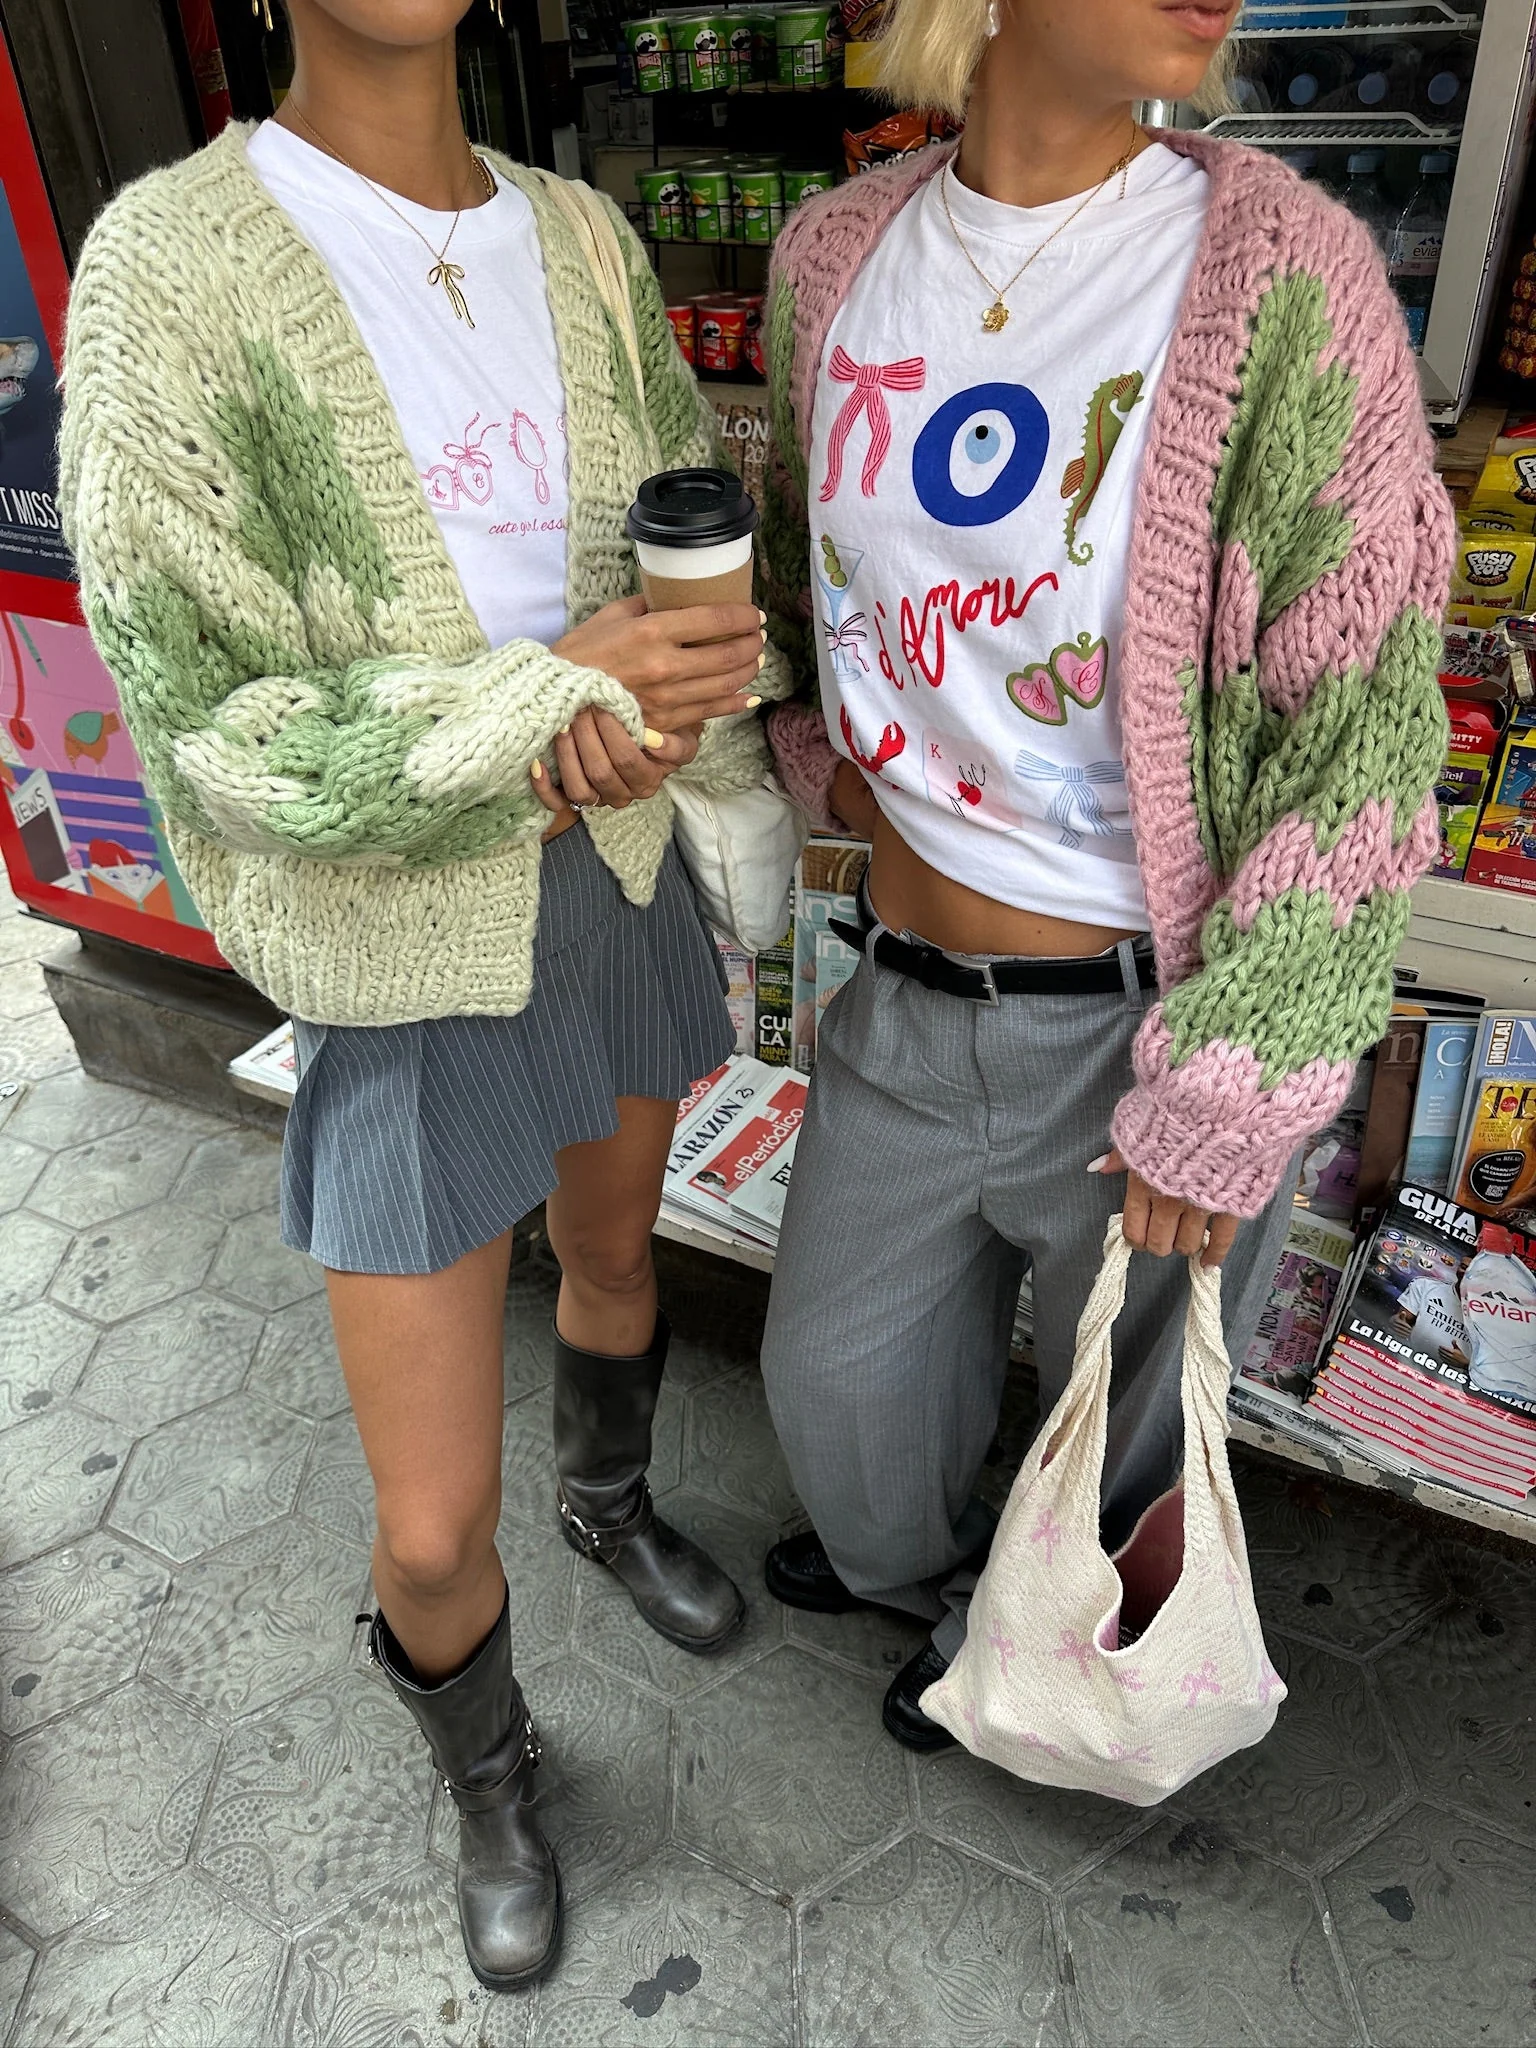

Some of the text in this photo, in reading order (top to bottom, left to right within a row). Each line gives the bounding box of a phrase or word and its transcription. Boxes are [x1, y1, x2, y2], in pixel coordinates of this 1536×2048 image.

[744, 445, 768, 464] 20
[10, 488, 59, 530] MISS
[488, 521, 518, 534] cute
[520, 518, 538, 536] girl
[1467, 551, 1515, 567] PUSH
[1473, 563, 1508, 576] POP
[930, 743, 942, 759] K
[760, 1030, 786, 1047] LA
[1488, 1021, 1513, 1064] ¡HOLA!
[682, 1098, 744, 1151] RAZÓN
[734, 1108, 804, 1181] elPeriódico
[1398, 1187, 1477, 1237] GUÍA
[1414, 1210, 1434, 1225] DE
[1433, 1219, 1451, 1234] LA
[1430, 1317, 1443, 1328] FLY
[1350, 1319, 1373, 1337] La
[1373, 1329, 1414, 1359] Liga
[1413, 1350, 1438, 1372] de
[1438, 1363, 1469, 1385] las
